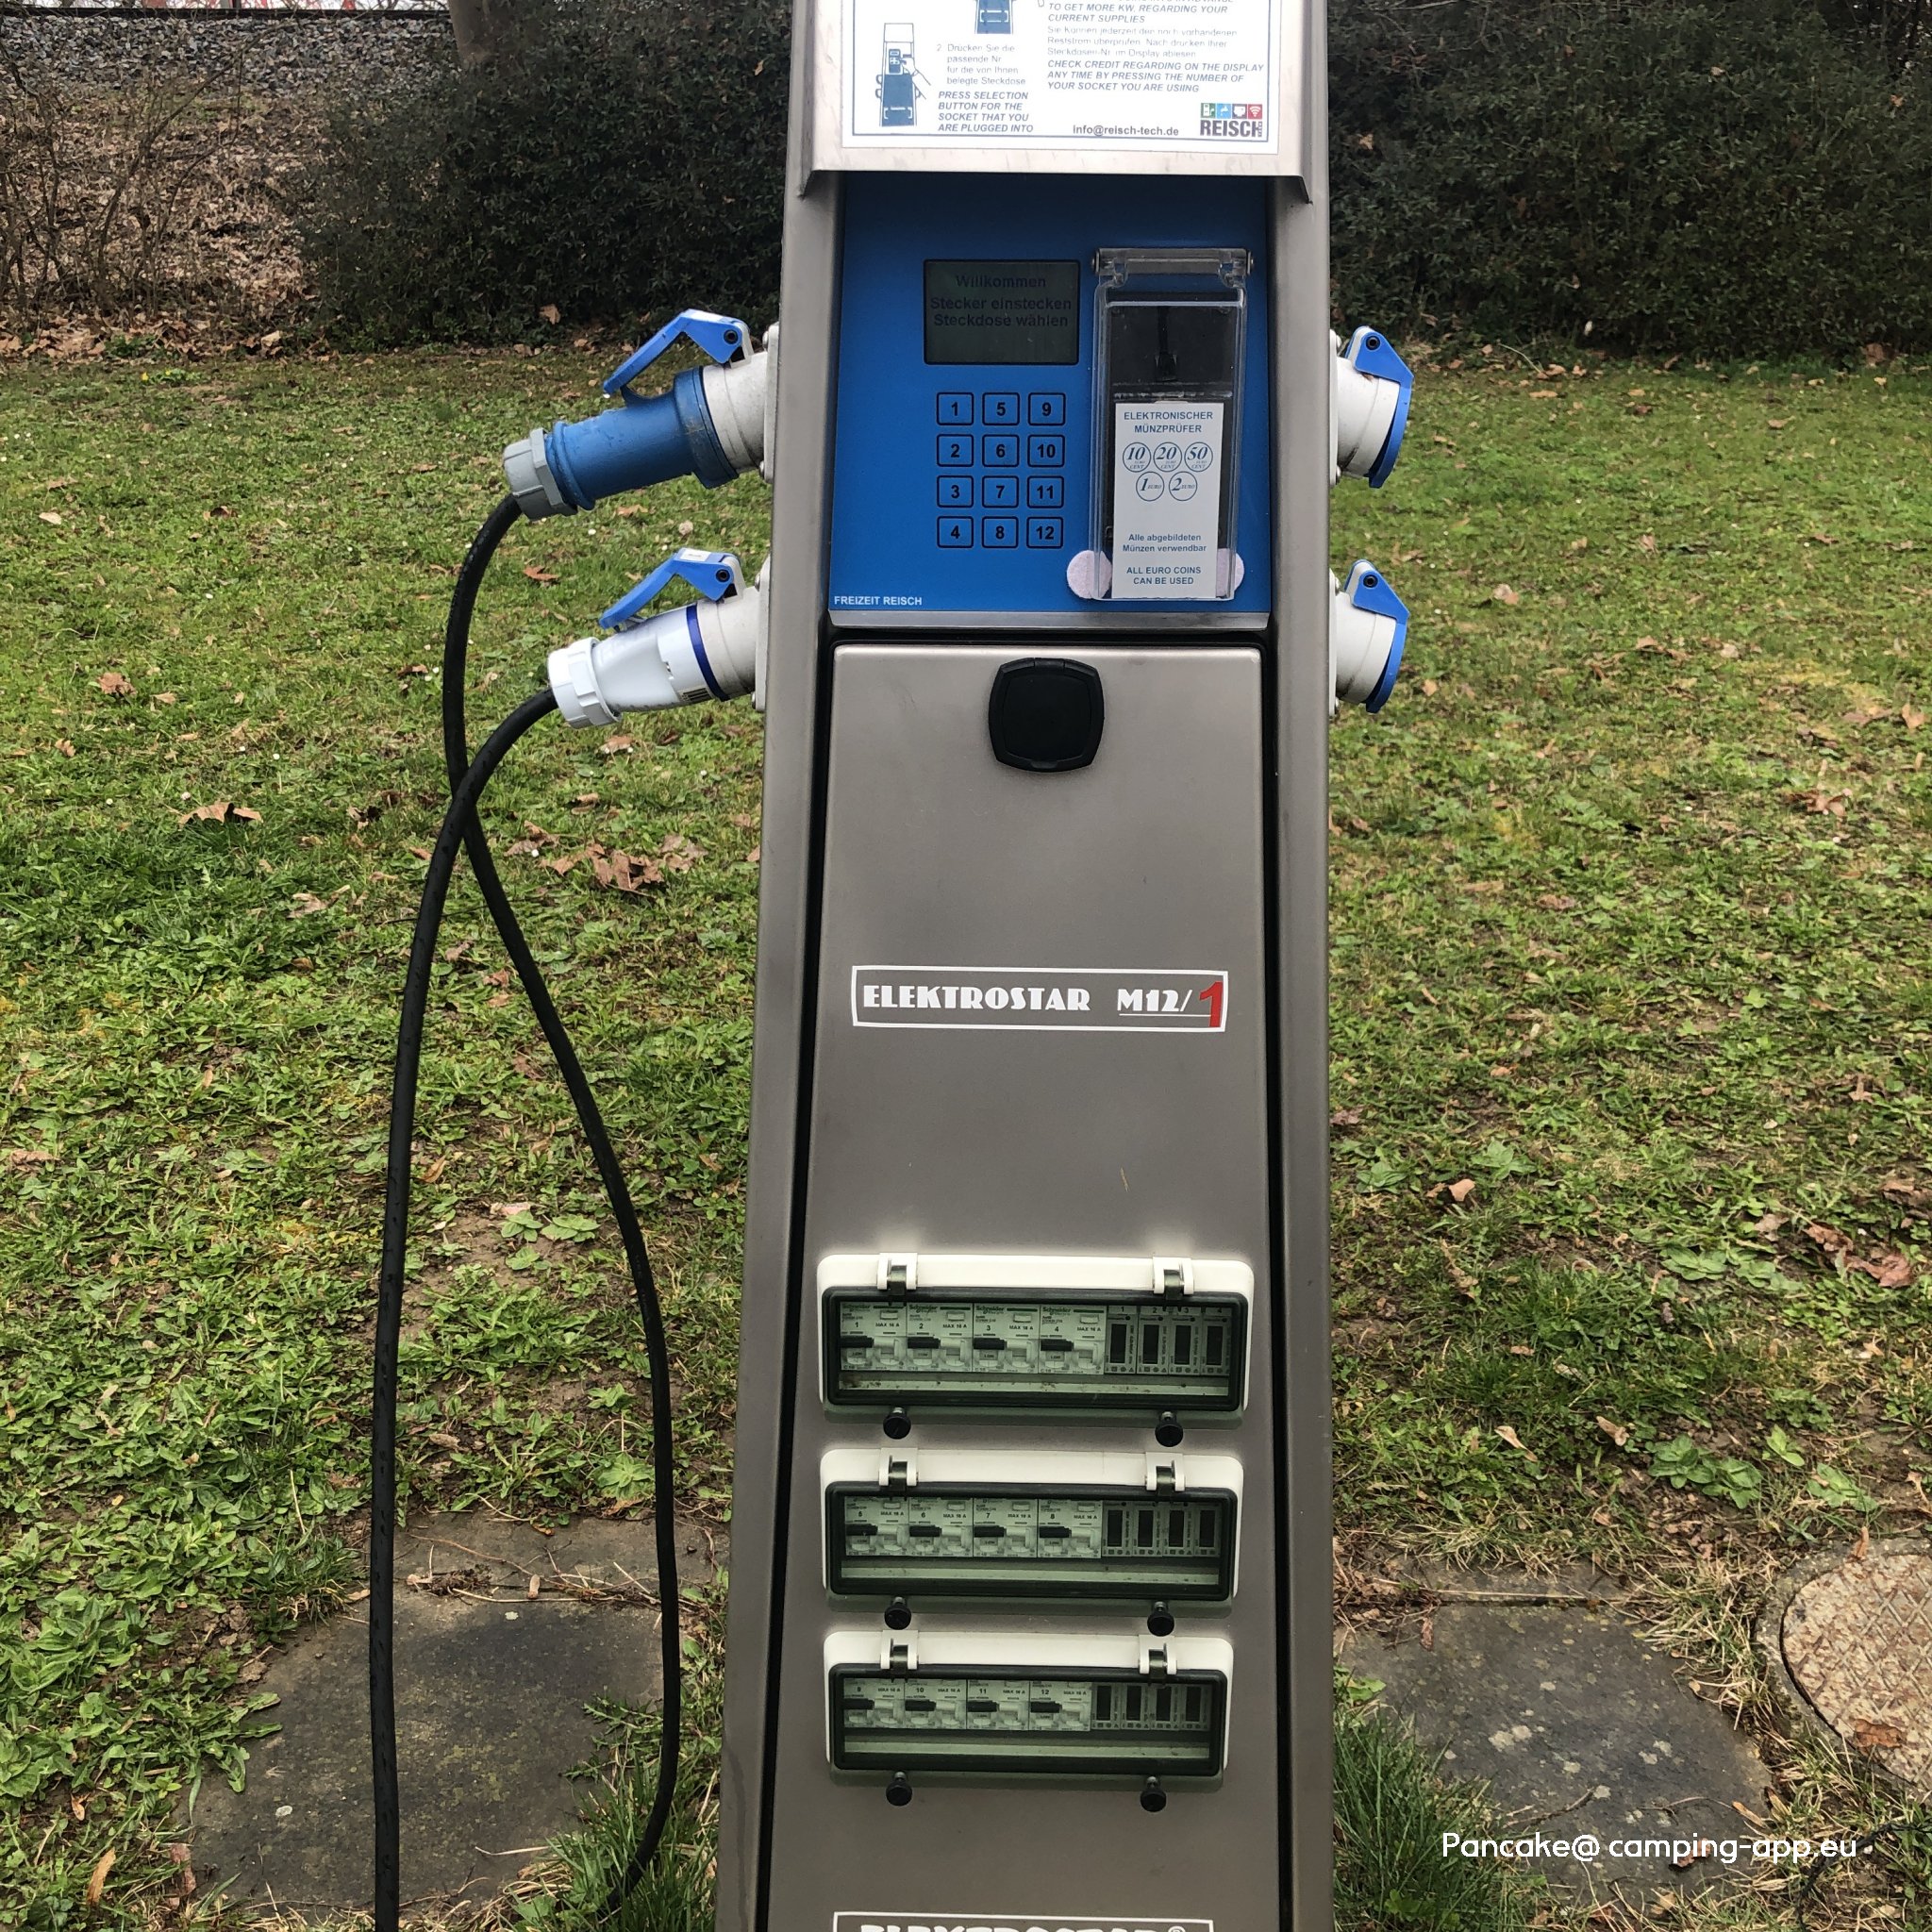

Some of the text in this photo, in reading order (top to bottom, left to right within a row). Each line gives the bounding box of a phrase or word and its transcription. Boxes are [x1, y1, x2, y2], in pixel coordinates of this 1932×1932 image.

[1139, 5, 1197, 13] REGARDING
[1201, 5, 1227, 13] YOUR
[1048, 13, 1094, 22] CURRENT
[947, 56, 989, 64] passende
[1047, 59, 1264, 72] CHECK CREDIT REGARDING ON THE DISPLAY
[946, 76, 1025, 87] belegte Steckdose
[1047, 71, 1068, 79] ANY
[1071, 71, 1092, 79] TIME
[1111, 72, 1161, 81] PRESSING
[1164, 73, 1183, 81] THE
[1186, 74, 1227, 82] NUMBER
[1230, 74, 1244, 82] OF
[1048, 81, 1074, 90] YOUR
[1077, 82, 1118, 91] SOCKET
[1121, 83, 1141, 92] YOU
[1143, 83, 1163, 92] ARE
[973, 92, 1028, 100] SELECTION
[938, 102, 978, 110] BUTTON
[980, 102, 1001, 110] FOR
[938, 113, 1029, 122] SOCKET THAT YOU
[938, 124, 1034, 133] ARE PLUGGED INTO
[1073, 125, 1179, 137] info@reisch-tech.de
[1200, 120, 1262, 138] REISCH
[955, 275, 1047, 288] Willkommen
[930, 296, 1072, 310] Stecker einstecken
[934, 313, 1068, 327] Steckdose wählen
[951, 402, 958, 416] 1
[996, 402, 1007, 416] 5
[1041, 402, 1052, 416] 9
[1124, 411, 1213, 420] ELEKTRONISCHER
[1134, 424, 1202, 433] MÜNZPRÜFER
[950, 443, 960, 458] 2
[995, 443, 1006, 458] 6
[1037, 443, 1056, 458] 10
[1127, 446, 1146, 460] 10
[1156, 446, 1177, 460] 20
[1187, 446, 1208, 460] 50
[1141, 477, 1149, 491] 1
[1171, 477, 1182, 491] 2
[950, 485, 960, 499] 3
[995, 485, 1006, 499] 7
[1037, 485, 1054, 499] 11
[950, 525, 960, 539] 4
[995, 525, 1005, 540] 8
[1036, 525, 1055, 540] 12
[1146, 534, 1201, 542] abgebildeten
[834, 596, 923, 606] FREIZEIT REISCH
[863, 985, 1091, 1011] ELEKTROSTAR
